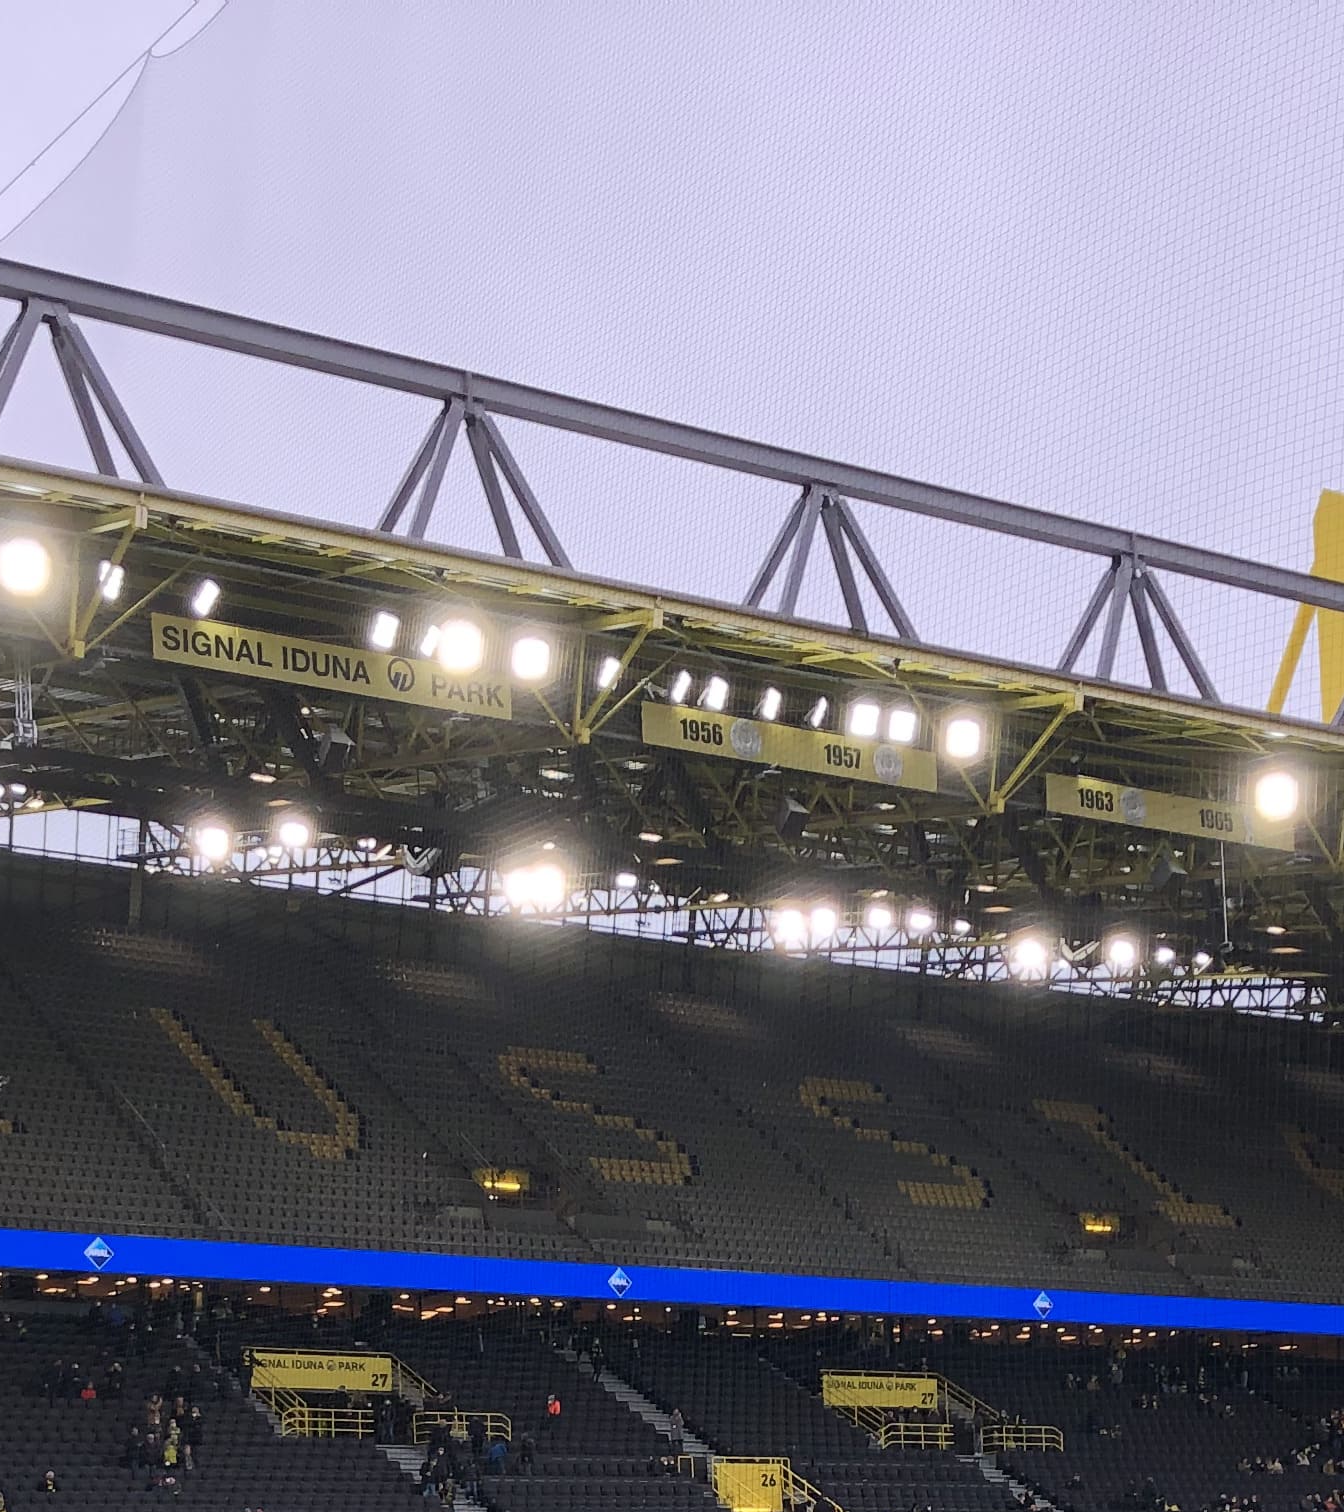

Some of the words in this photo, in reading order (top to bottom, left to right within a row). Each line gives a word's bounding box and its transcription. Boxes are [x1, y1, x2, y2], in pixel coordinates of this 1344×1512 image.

[161, 625, 272, 668] SIGNAL
[281, 645, 370, 685] IDUNA
[431, 672, 504, 708] PARK
[677, 719, 722, 746] 1956
[822, 744, 861, 771] 1957
[1077, 787, 1114, 813] 1963
[291, 1359, 325, 1371] IDUNA
[338, 1361, 367, 1372] PARK
[371, 1373, 388, 1388] 27
[894, 1381, 917, 1391] PARK
[921, 1392, 935, 1405] 27
[761, 1474, 777, 1487] 26
